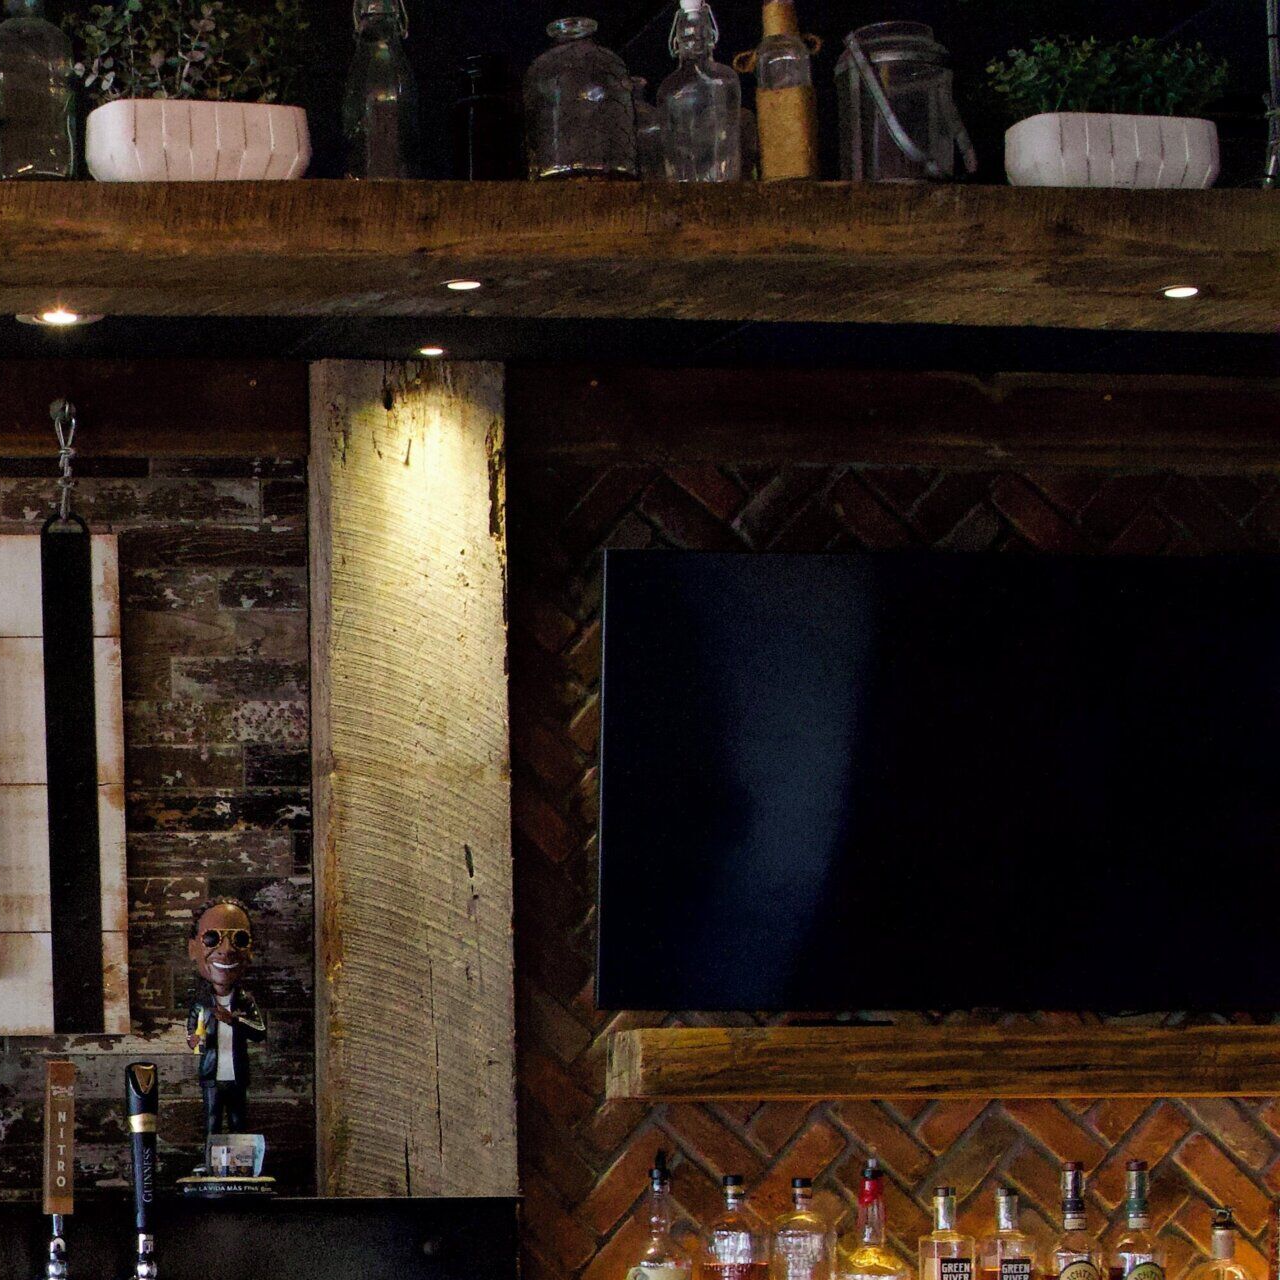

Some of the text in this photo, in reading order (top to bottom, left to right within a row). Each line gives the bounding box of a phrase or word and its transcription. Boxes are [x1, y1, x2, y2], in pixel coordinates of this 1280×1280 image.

[57, 1110, 67, 1187] NITRO
[141, 1147, 153, 1203] GUINNESS
[941, 1262, 970, 1273] GREEN
[1001, 1263, 1030, 1274] GREEN
